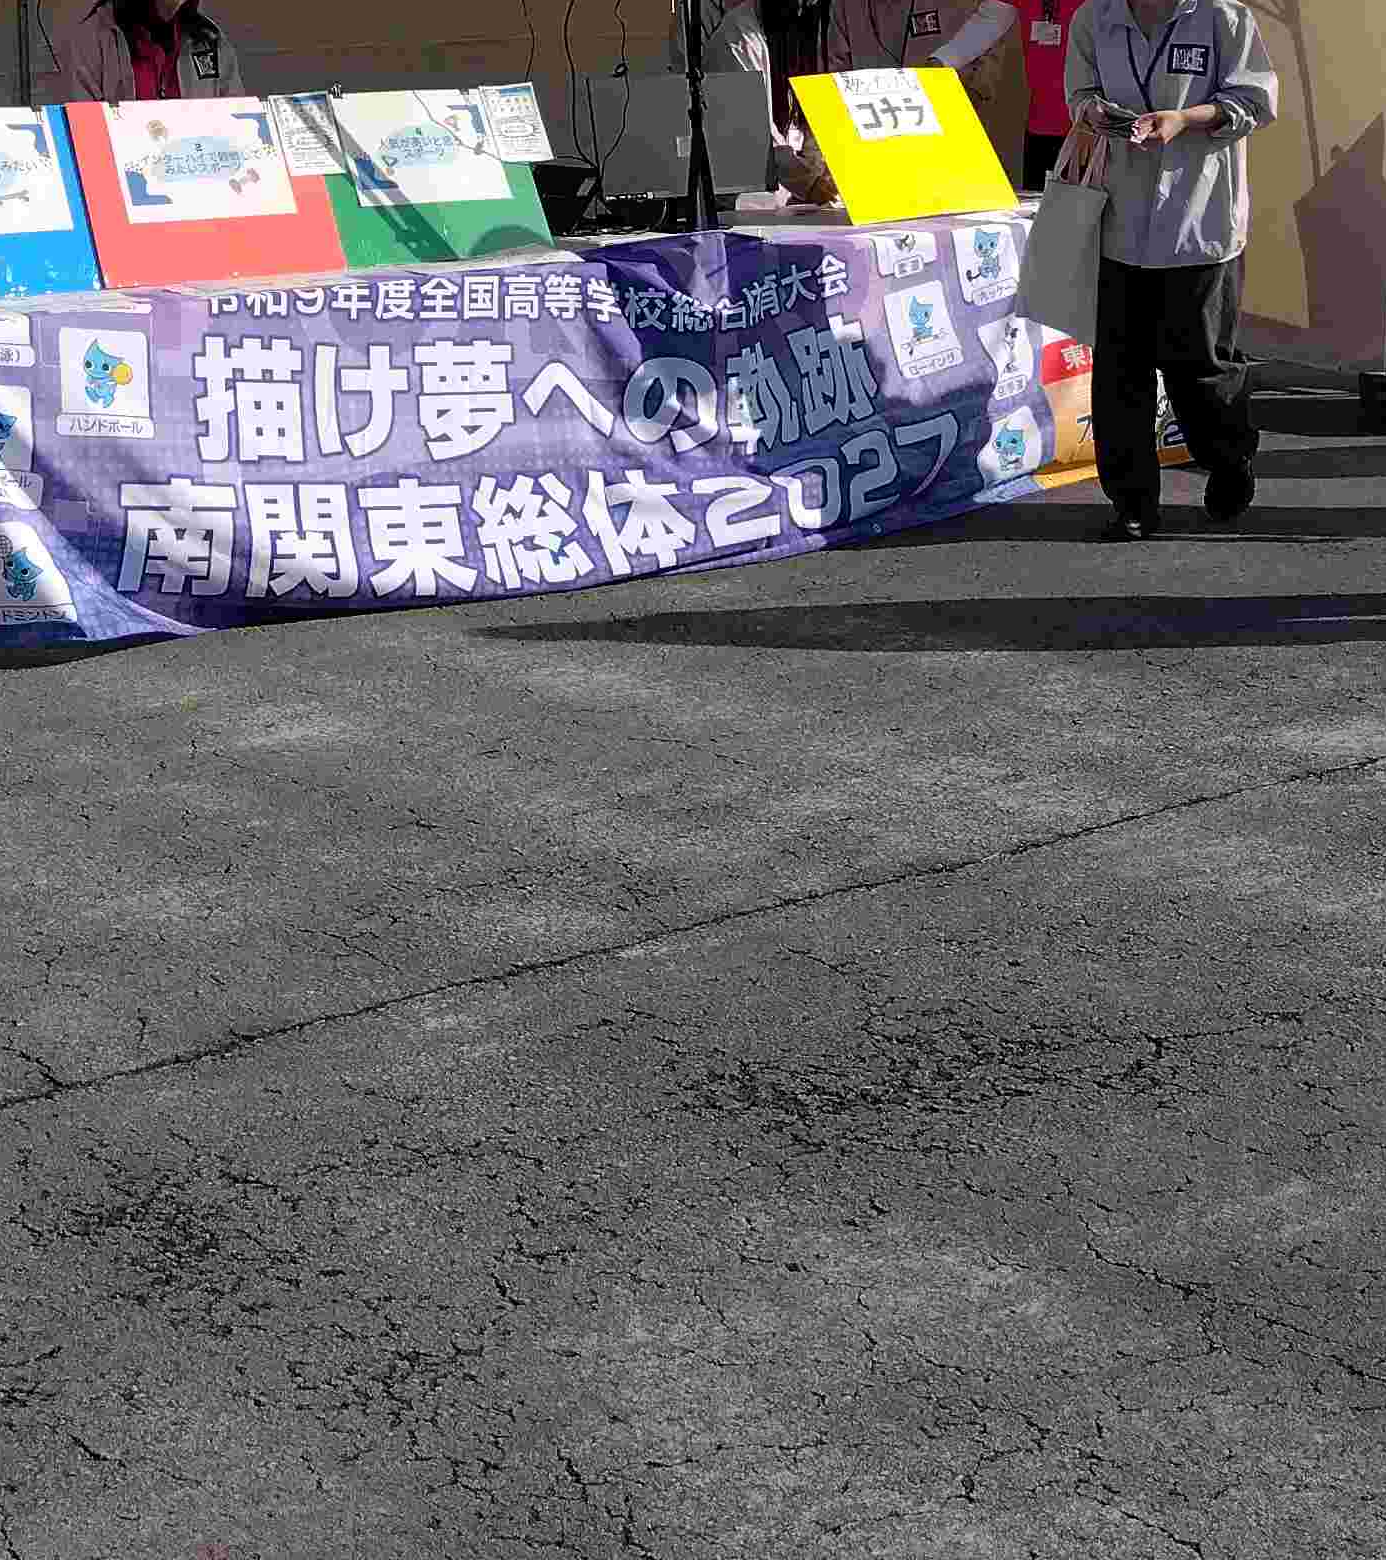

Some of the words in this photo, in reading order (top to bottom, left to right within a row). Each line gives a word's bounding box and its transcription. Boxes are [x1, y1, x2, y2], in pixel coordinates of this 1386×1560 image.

[69, 416, 144, 435] ハンドボール
[193, 313, 878, 463] 描け夢への軌跡
[116, 412, 960, 599] 南関東総体2027
